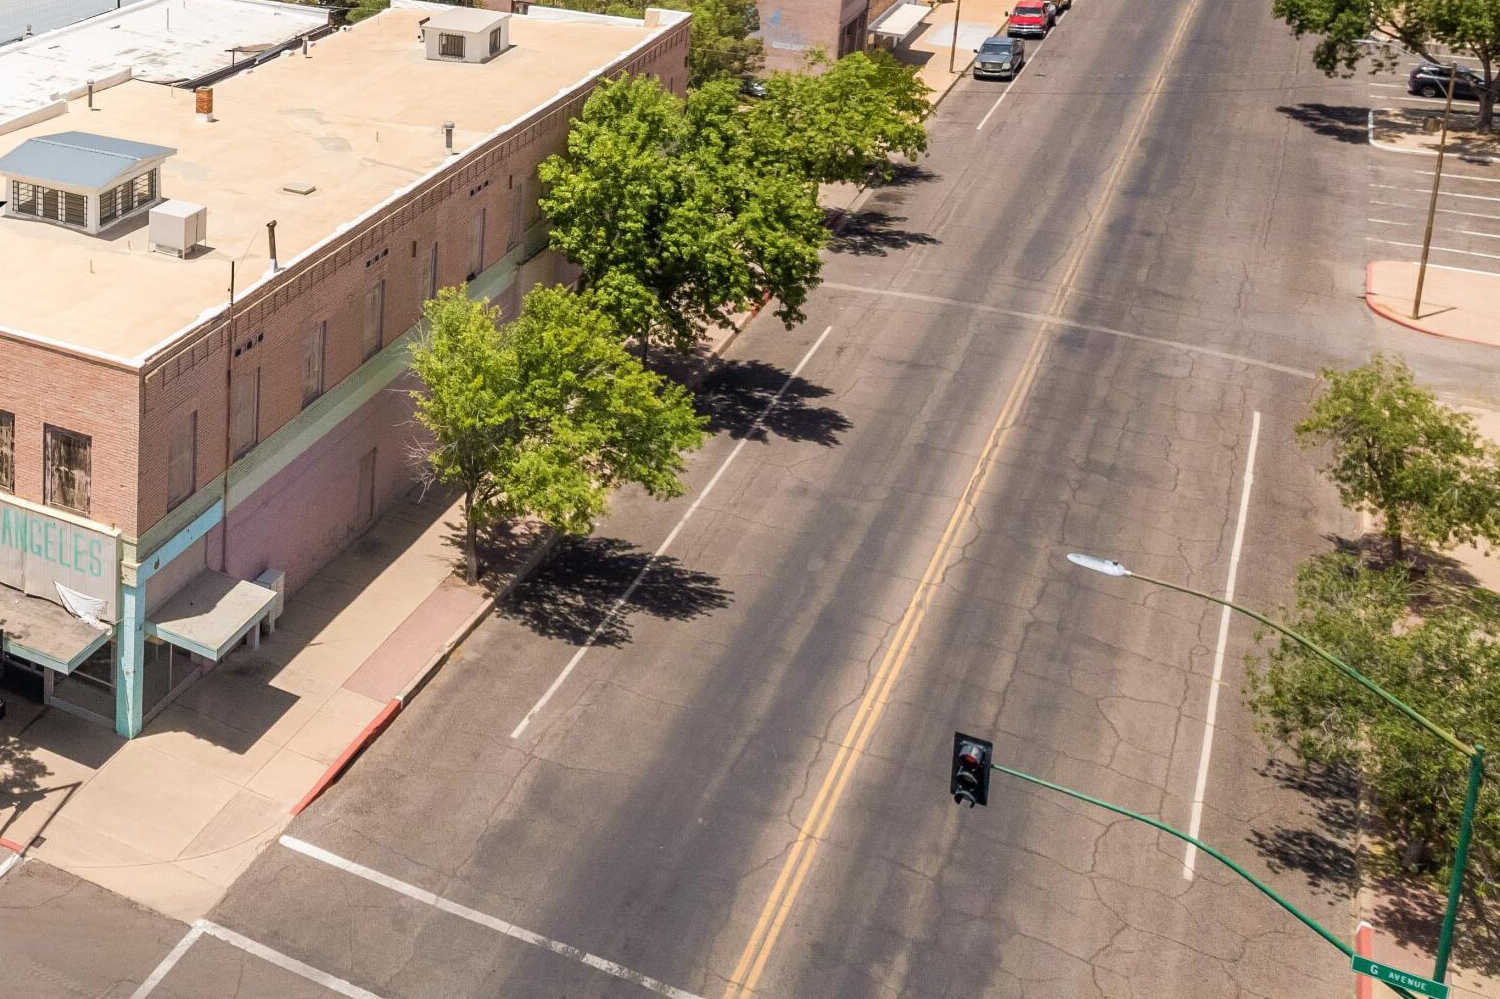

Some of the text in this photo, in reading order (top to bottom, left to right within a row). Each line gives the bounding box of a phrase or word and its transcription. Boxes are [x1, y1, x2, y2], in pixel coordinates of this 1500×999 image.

[2, 508, 102, 577] ANGELES
[1370, 964, 1427, 991] G AVENUE
